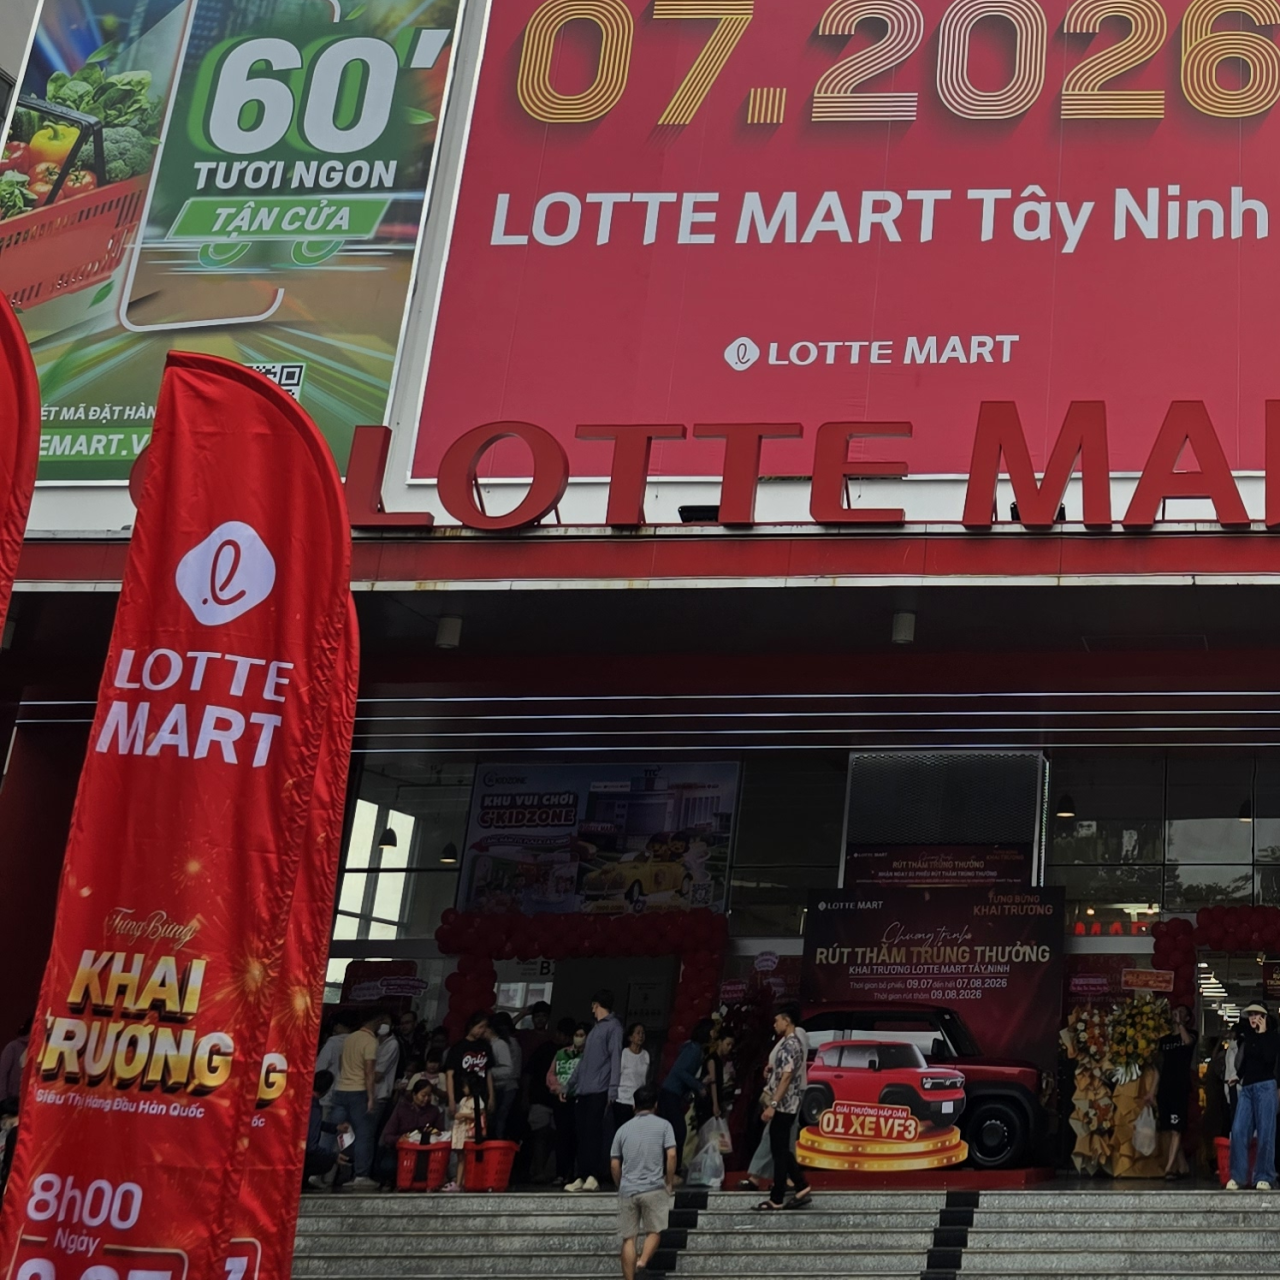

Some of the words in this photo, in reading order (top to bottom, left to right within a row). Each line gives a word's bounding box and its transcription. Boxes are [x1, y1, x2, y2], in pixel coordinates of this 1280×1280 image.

[194, 161, 284, 190] TƯƠI
[291, 160, 397, 188] NGON
[211, 205, 281, 237] TẬN
[282, 198, 350, 231] CỬA
[490, 191, 719, 245] LOTTE
[735, 189, 952, 244] MART
[967, 184, 1095, 254] Tây
[1112, 184, 1270, 241] Ninh
[768, 340, 894, 365] LOTTE
[903, 335, 1019, 364] MART
[60, 404, 86, 420] MÃ
[88, 404, 123, 423] ĐẶT
[345, 420, 913, 529] LOTTE
[113, 648, 294, 702] LOTTE
[95, 700, 282, 768] MART
[484, 795, 511, 806] KHU
[516, 795, 539, 805] VUI
[542, 793, 574, 805] CHƠI
[857, 901, 883, 909] MART
[973, 905, 1000, 916] KHAI
[1003, 904, 1053, 915] TRƯƠNG
[816, 943, 852, 965] RÚT
[855, 943, 906, 964] THĂM
[910, 943, 970, 964] TRÚNG
[974, 942, 1051, 963] THƯỞNG
[849, 966, 871, 974] KHAI
[872, 965, 910, 974] TRƯƠNG
[912, 965, 939, 974] LOTTE
[941, 964, 965, 973] MART
[987, 964, 1010, 973] NINH
[67, 949, 207, 1018] KHAI
[906, 979, 932, 988] 09.07
[956, 978, 1007, 988] 07.08.2026
[930, 990, 982, 1000] 09.08.2026
[462, 1051, 487, 1068] Only
[138, 1100, 166, 1115] Hàn
[169, 1102, 205, 1118] Quốc
[822, 1113, 845, 1133] 01
[848, 1115, 877, 1136] XE
[879, 1117, 917, 1140] VF3
[26, 1173, 143, 1230] 8h00
[54, 1227, 101, 1257] Ngày
